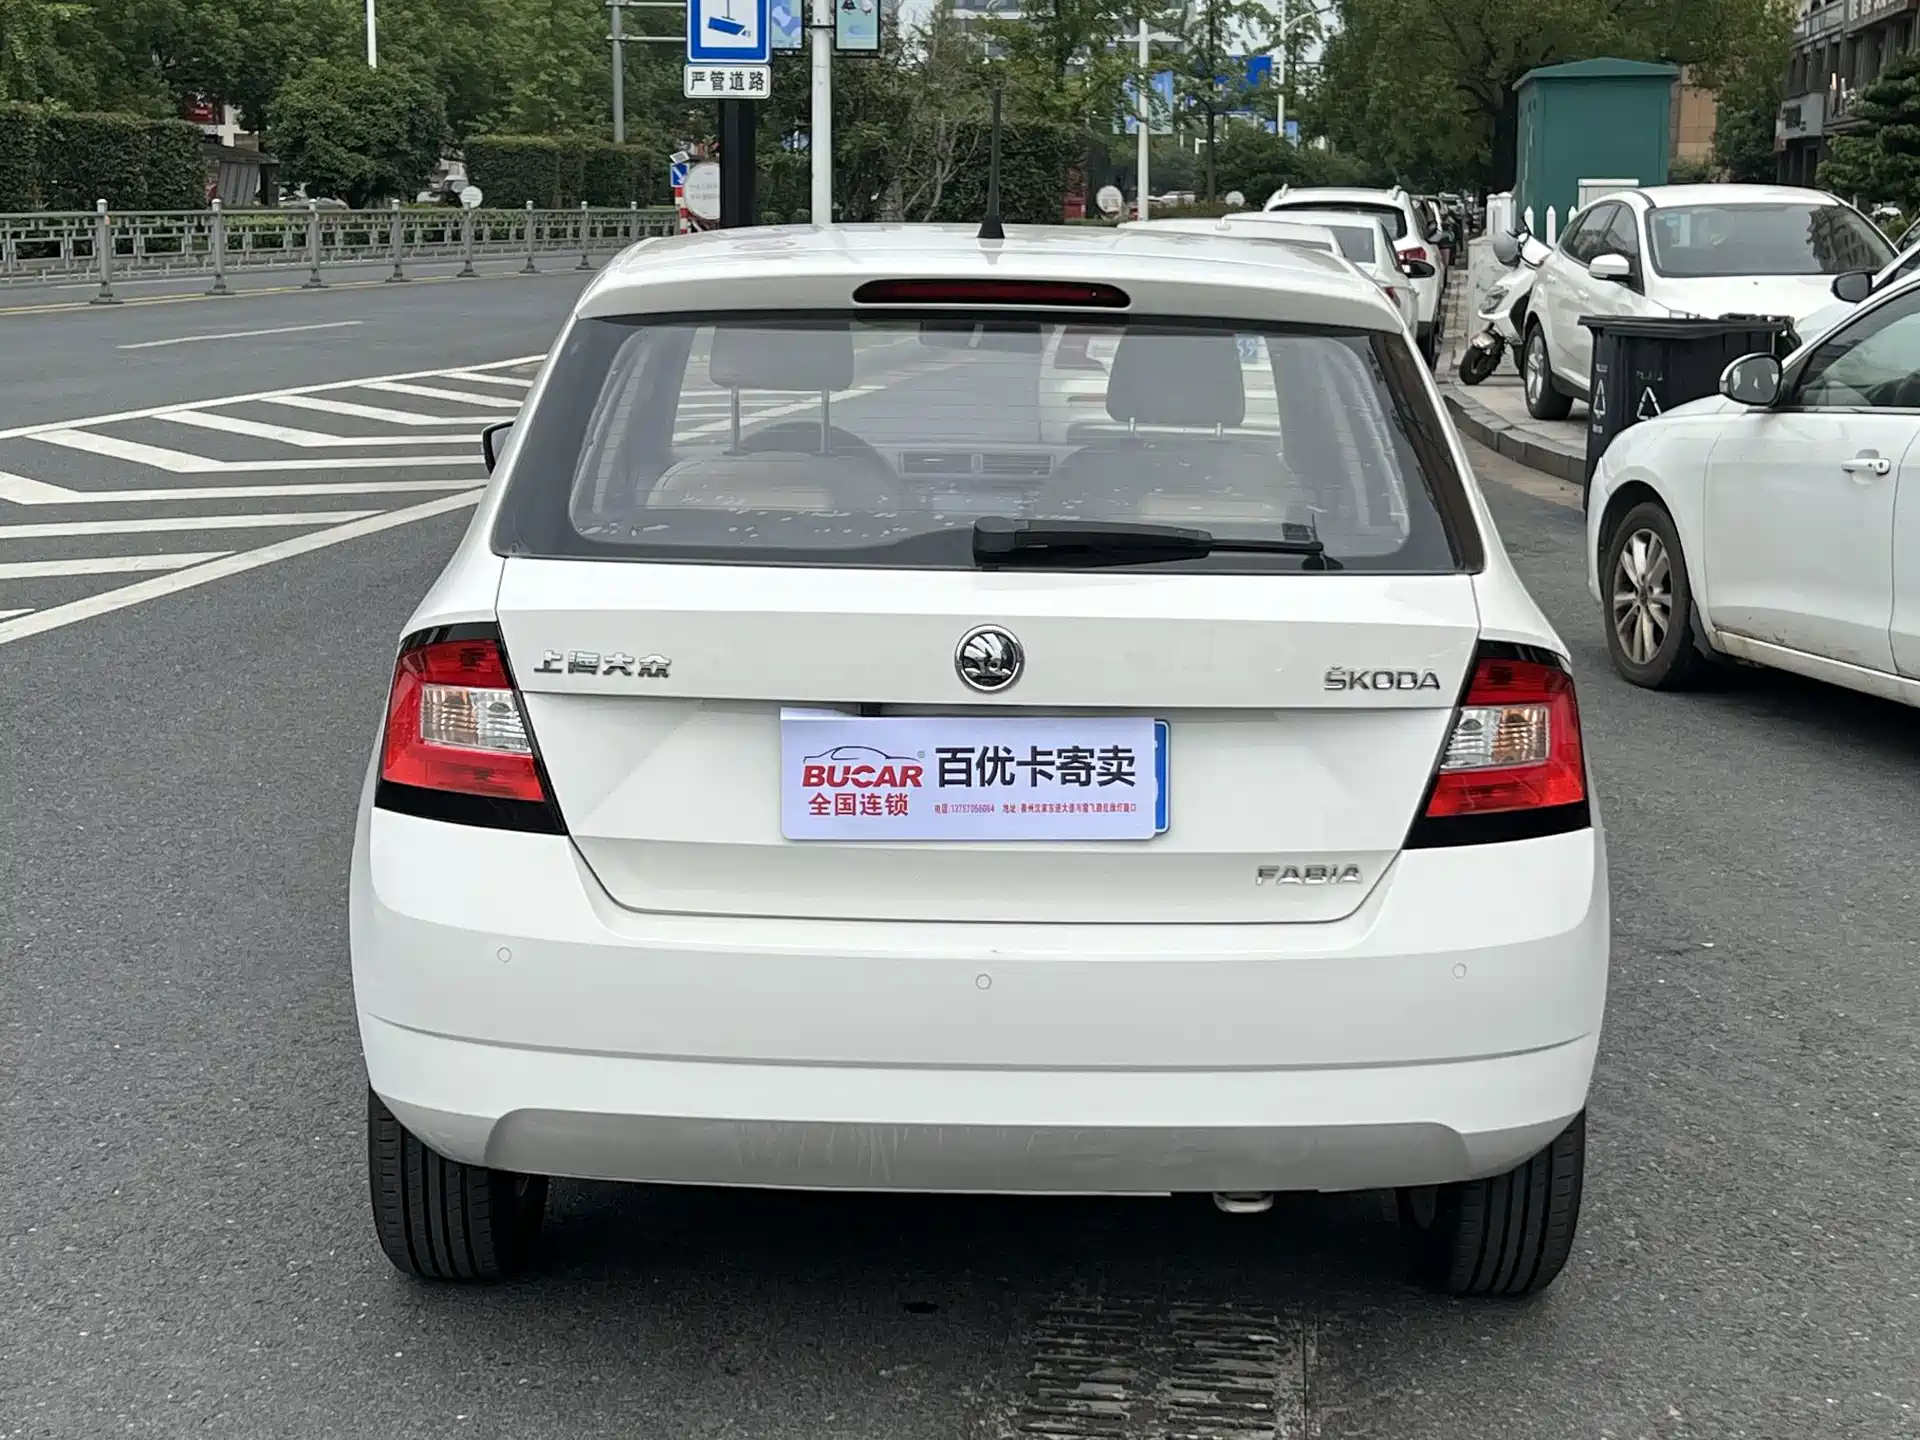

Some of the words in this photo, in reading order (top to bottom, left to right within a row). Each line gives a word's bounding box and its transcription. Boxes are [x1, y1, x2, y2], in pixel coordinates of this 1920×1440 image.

[690, 71, 765, 91] 严管道路
[534, 649, 671, 678] 上海大众
[1324, 665, 1440, 690] ŠKODA
[802, 765, 923, 788] BUCAR
[935, 746, 1136, 788] 百优卡寄卖
[808, 792, 909, 816] 全国连锁
[1256, 864, 1362, 885] FABIA
